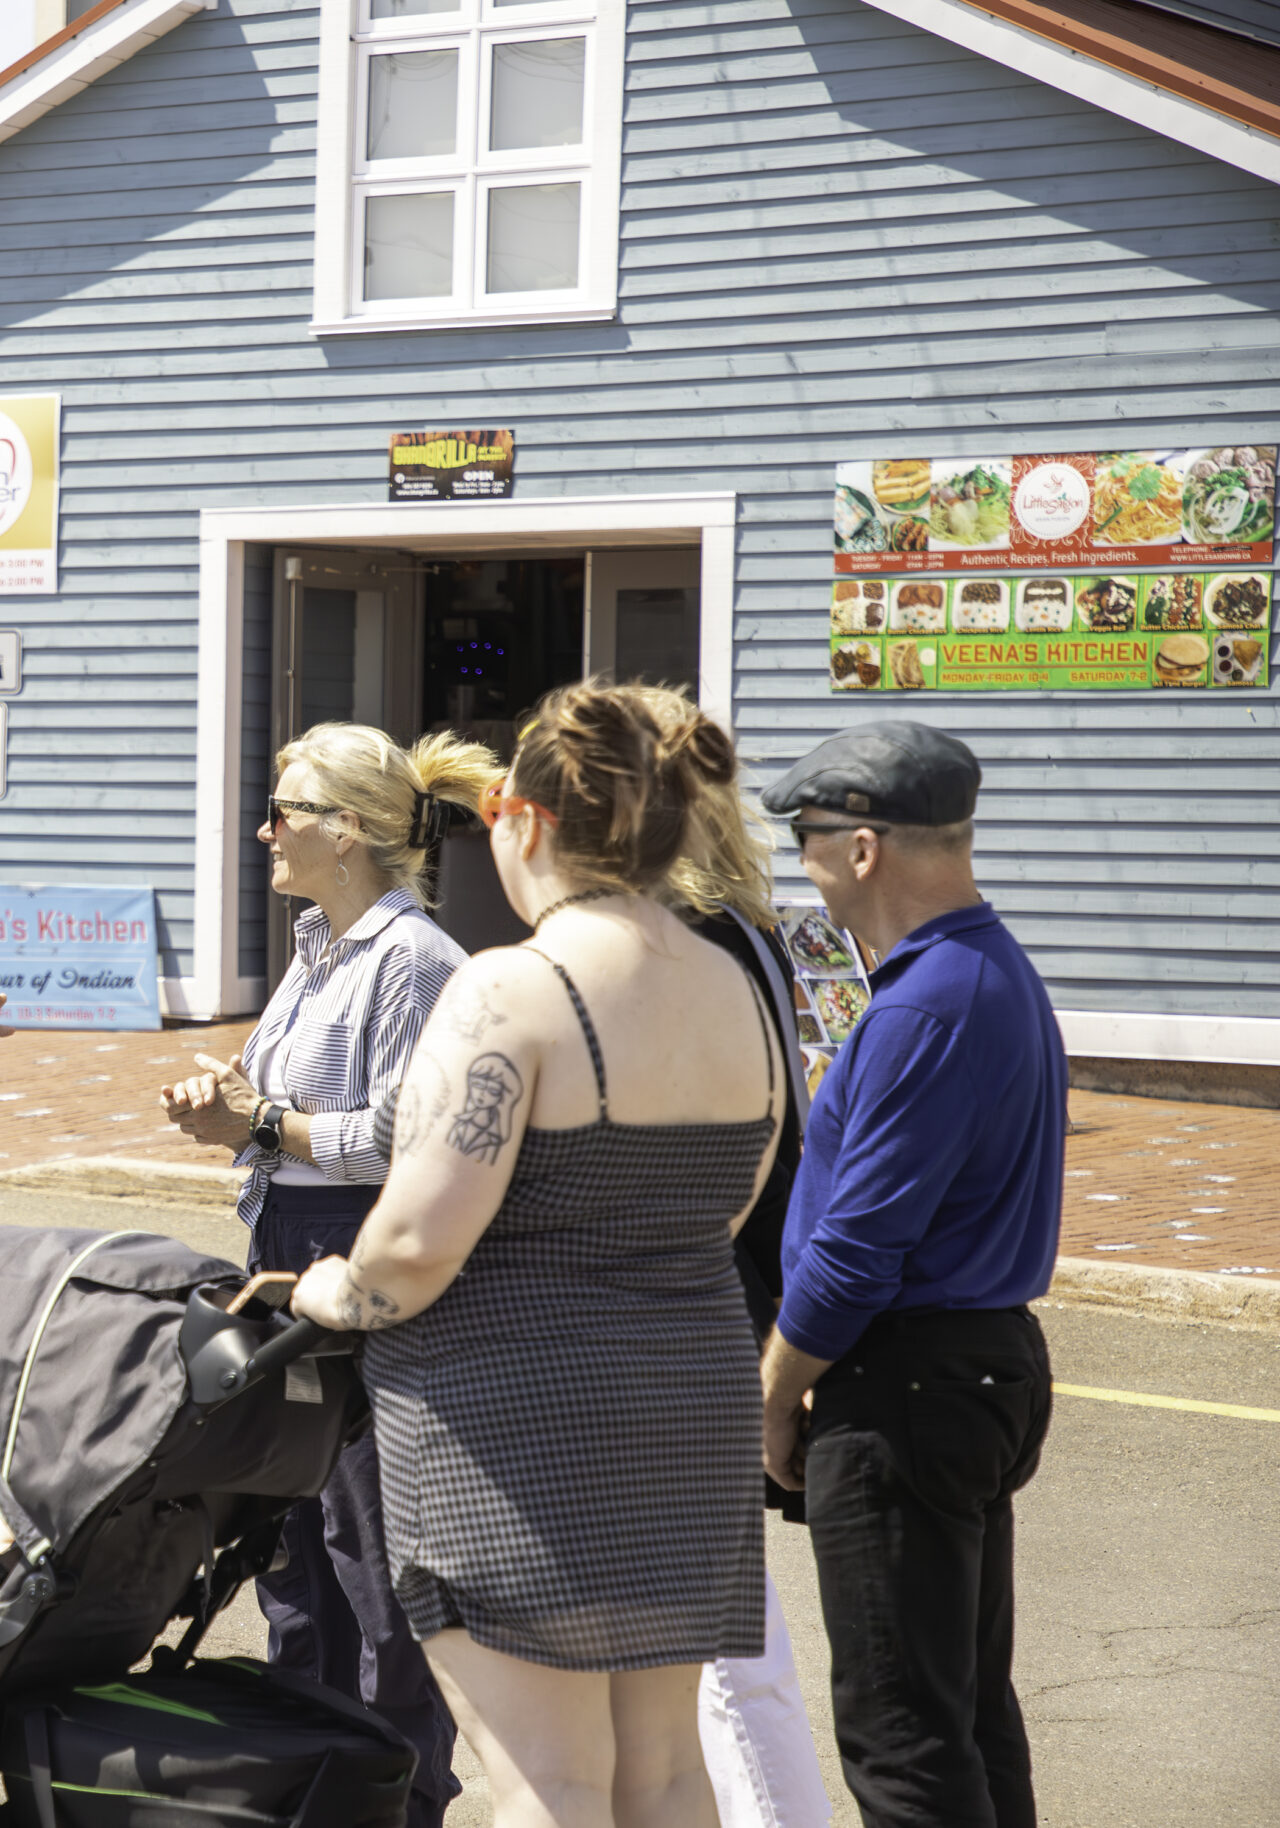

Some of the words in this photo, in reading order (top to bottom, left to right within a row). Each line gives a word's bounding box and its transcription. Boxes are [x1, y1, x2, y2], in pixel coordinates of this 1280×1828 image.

[961, 553, 1009, 566] Authentic
[1051, 551, 1078, 563] Fresh
[1080, 551, 1139, 566] Ingredients.
[942, 643, 1039, 664] VEENA'S
[1046, 641, 1148, 663] KITCHEN
[1071, 671, 1126, 682] SATURDAY
[37, 909, 148, 943] Kitchen
[31, 969, 52, 995] of
[56, 968, 137, 990] Indian
[45, 1007, 94, 1021] Saturday
